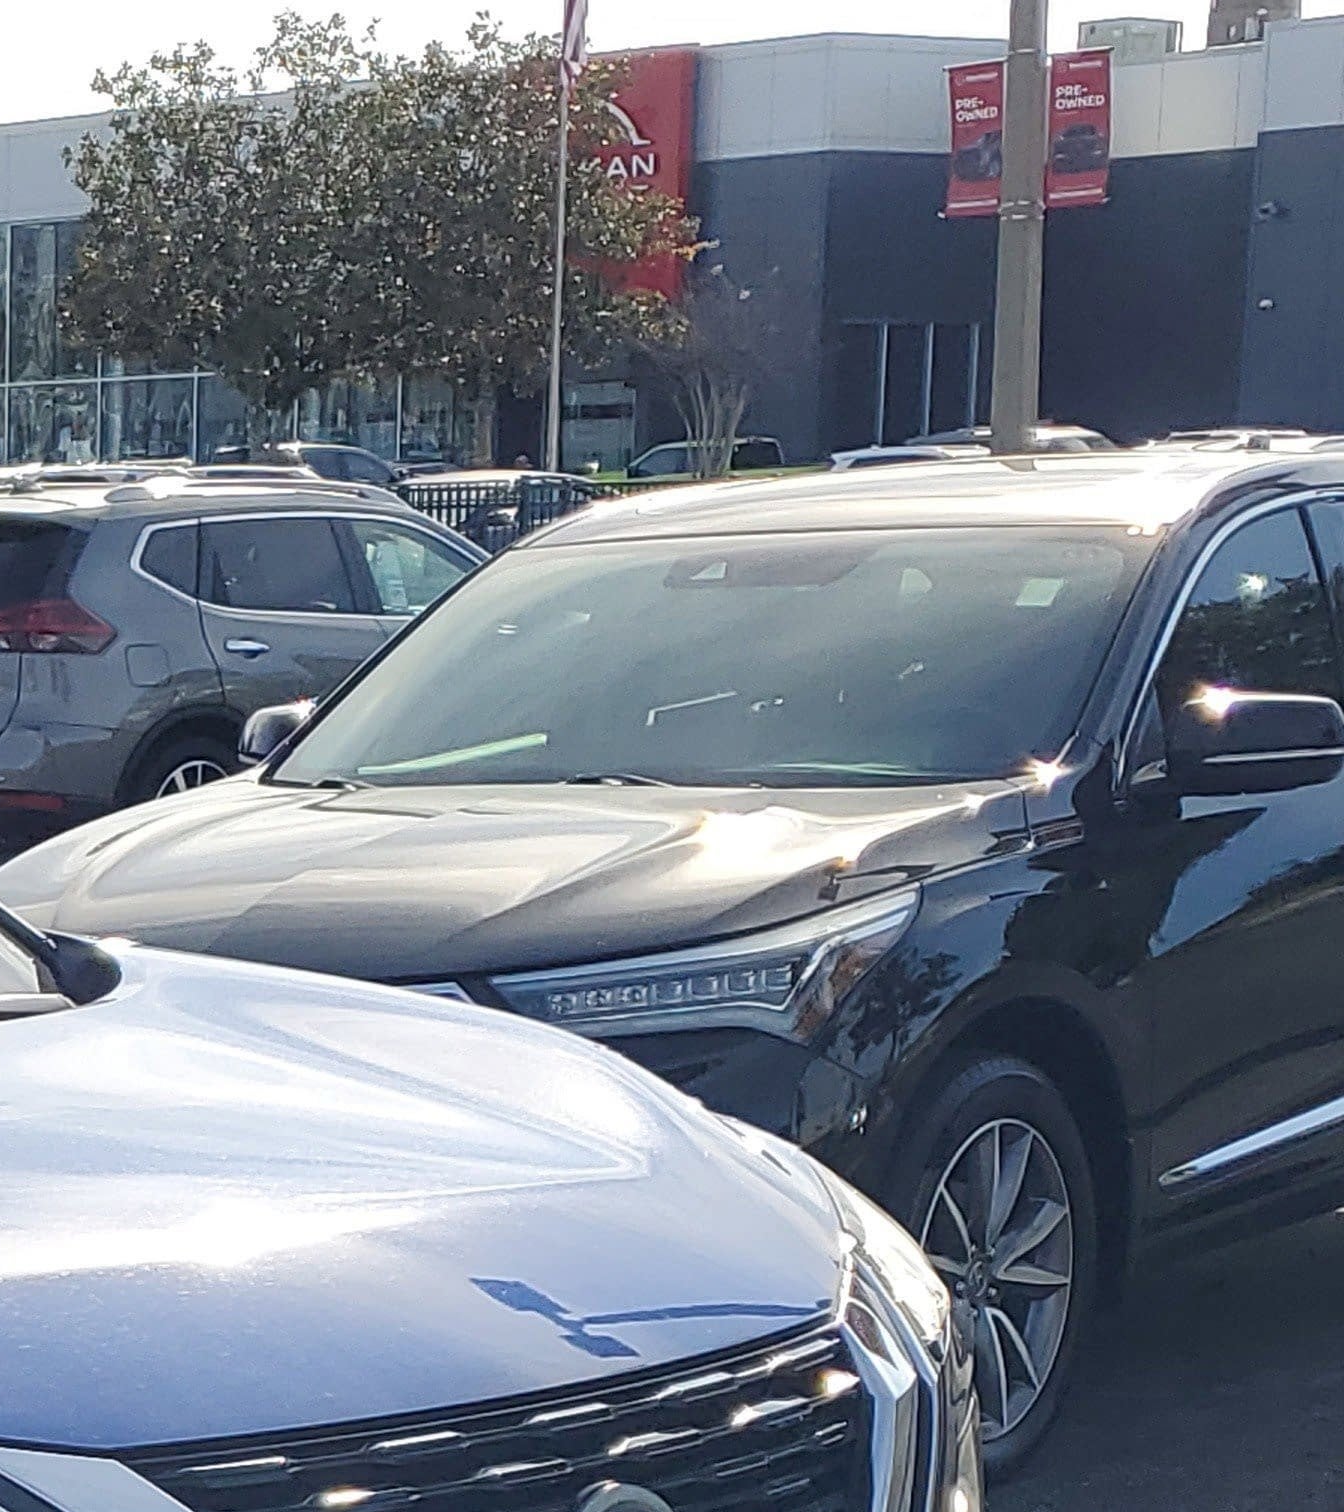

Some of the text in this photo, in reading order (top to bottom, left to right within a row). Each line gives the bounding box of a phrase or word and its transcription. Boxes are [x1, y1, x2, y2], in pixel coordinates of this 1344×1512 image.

[1055, 84, 1088, 98] PRE-
[955, 97, 983, 110] PRE-
[1055, 94, 1105, 109] OWNED
[955, 106, 998, 122] OWNED
